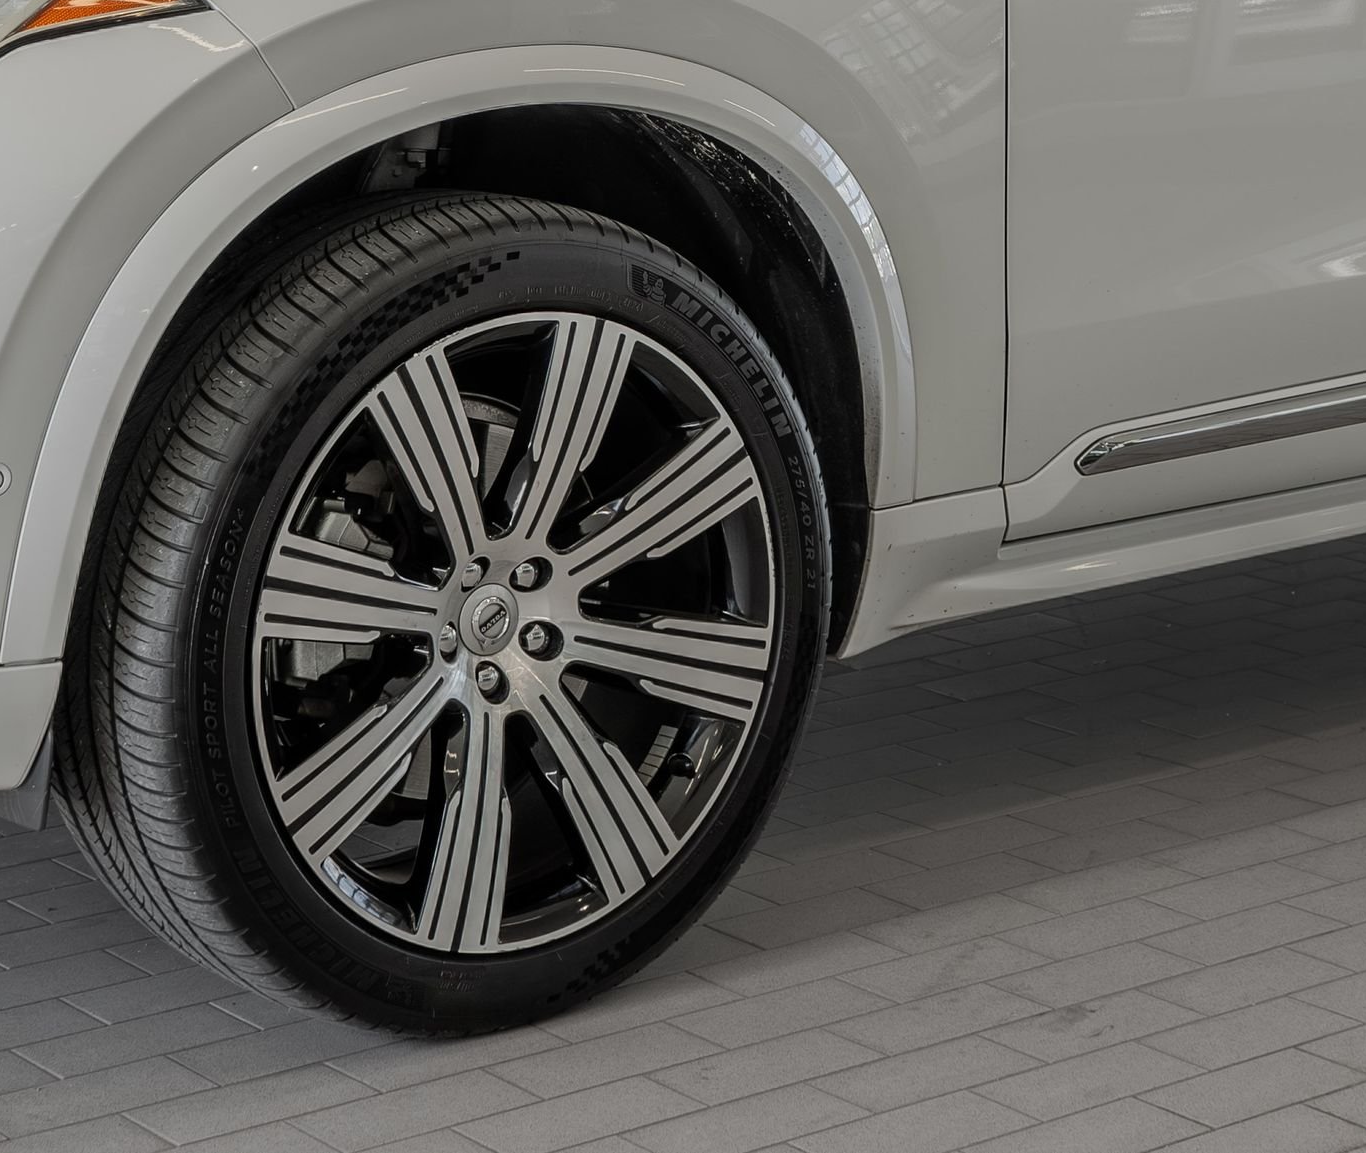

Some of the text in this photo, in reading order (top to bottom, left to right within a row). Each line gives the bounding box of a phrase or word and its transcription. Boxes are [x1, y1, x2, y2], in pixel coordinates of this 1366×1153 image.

[671, 291, 792, 438] MICHELIN
[788, 456, 812, 527] 275/40
[209, 519, 244, 619] SEASON
[804, 535, 815, 561] ZR
[806, 568, 817, 589] 21
[203, 628, 219, 675] ALL
[203, 682, 221, 760] SPORT
[211, 767, 240, 829] PILOT
